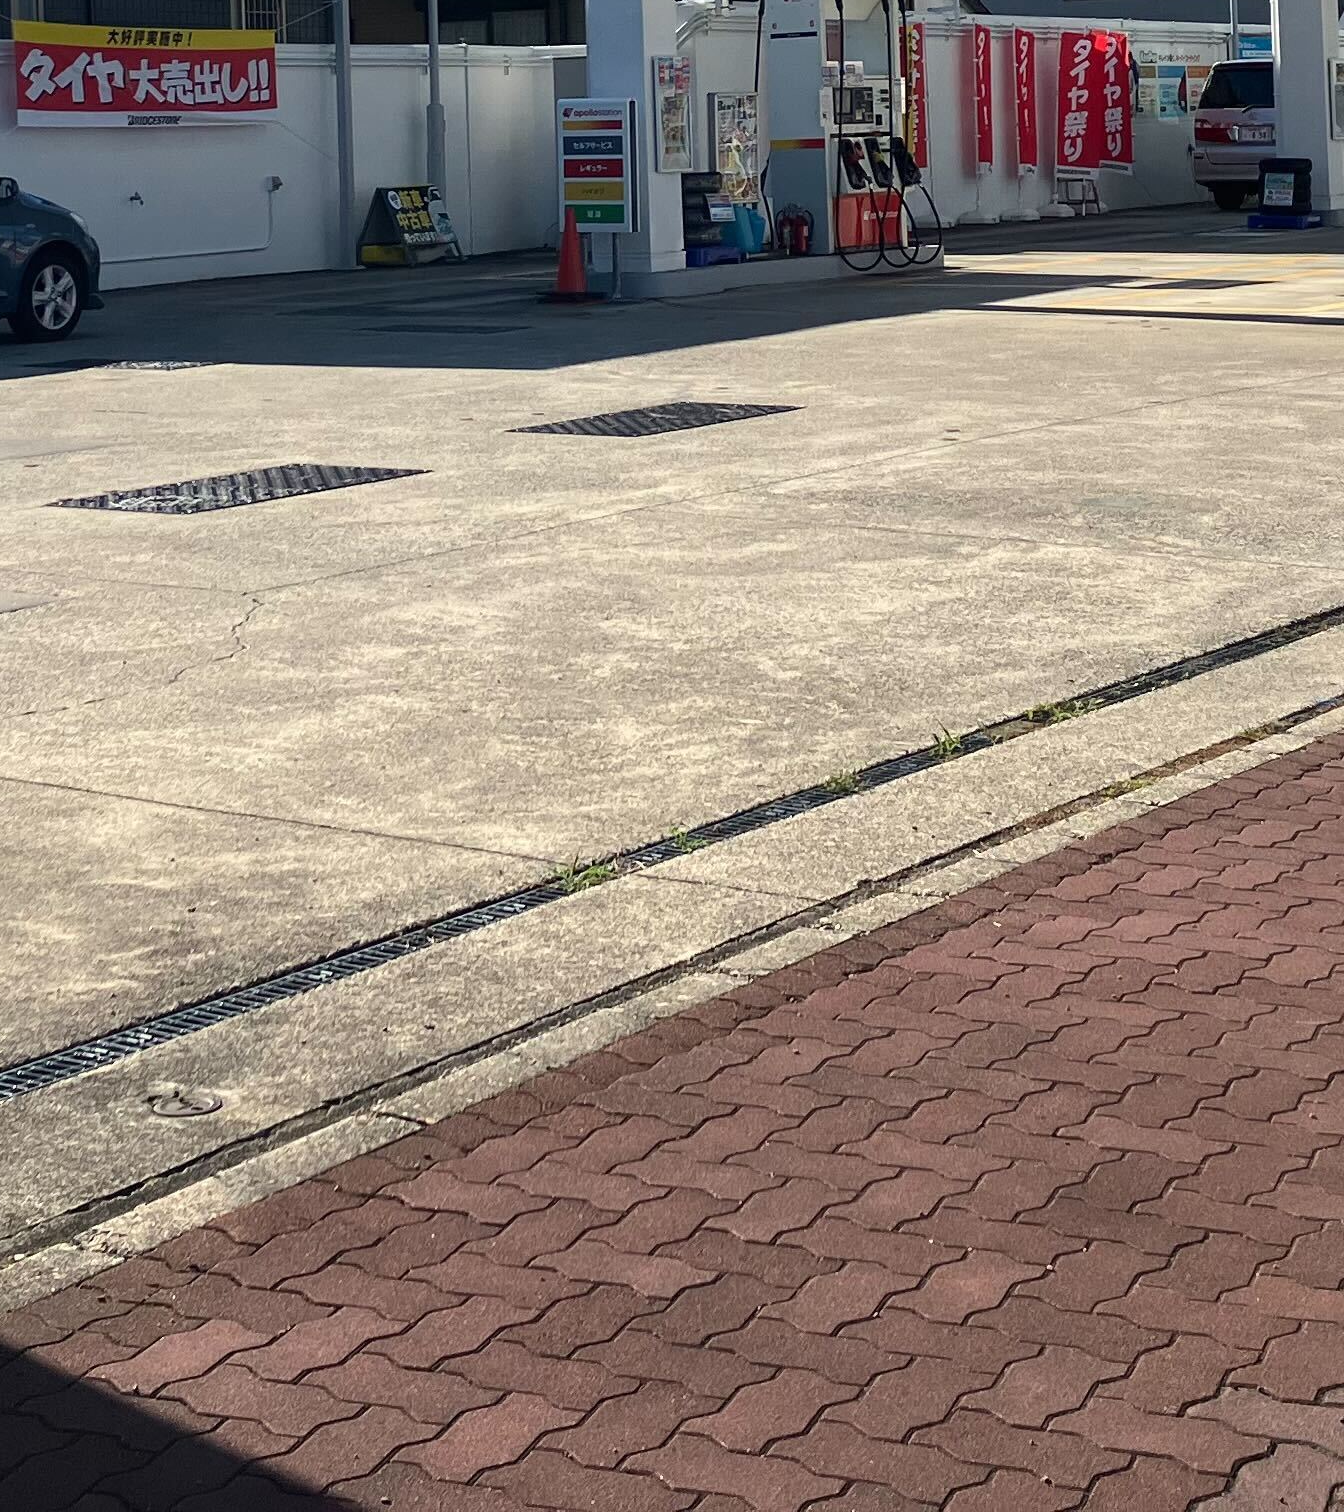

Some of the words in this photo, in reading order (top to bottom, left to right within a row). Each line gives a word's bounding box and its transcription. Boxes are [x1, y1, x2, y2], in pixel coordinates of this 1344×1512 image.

[20, 48, 270, 105] タイヤ大売出し!!
[1063, 38, 1092, 163] タイヤ祭り
[396, 211, 433, 231] 中古車
